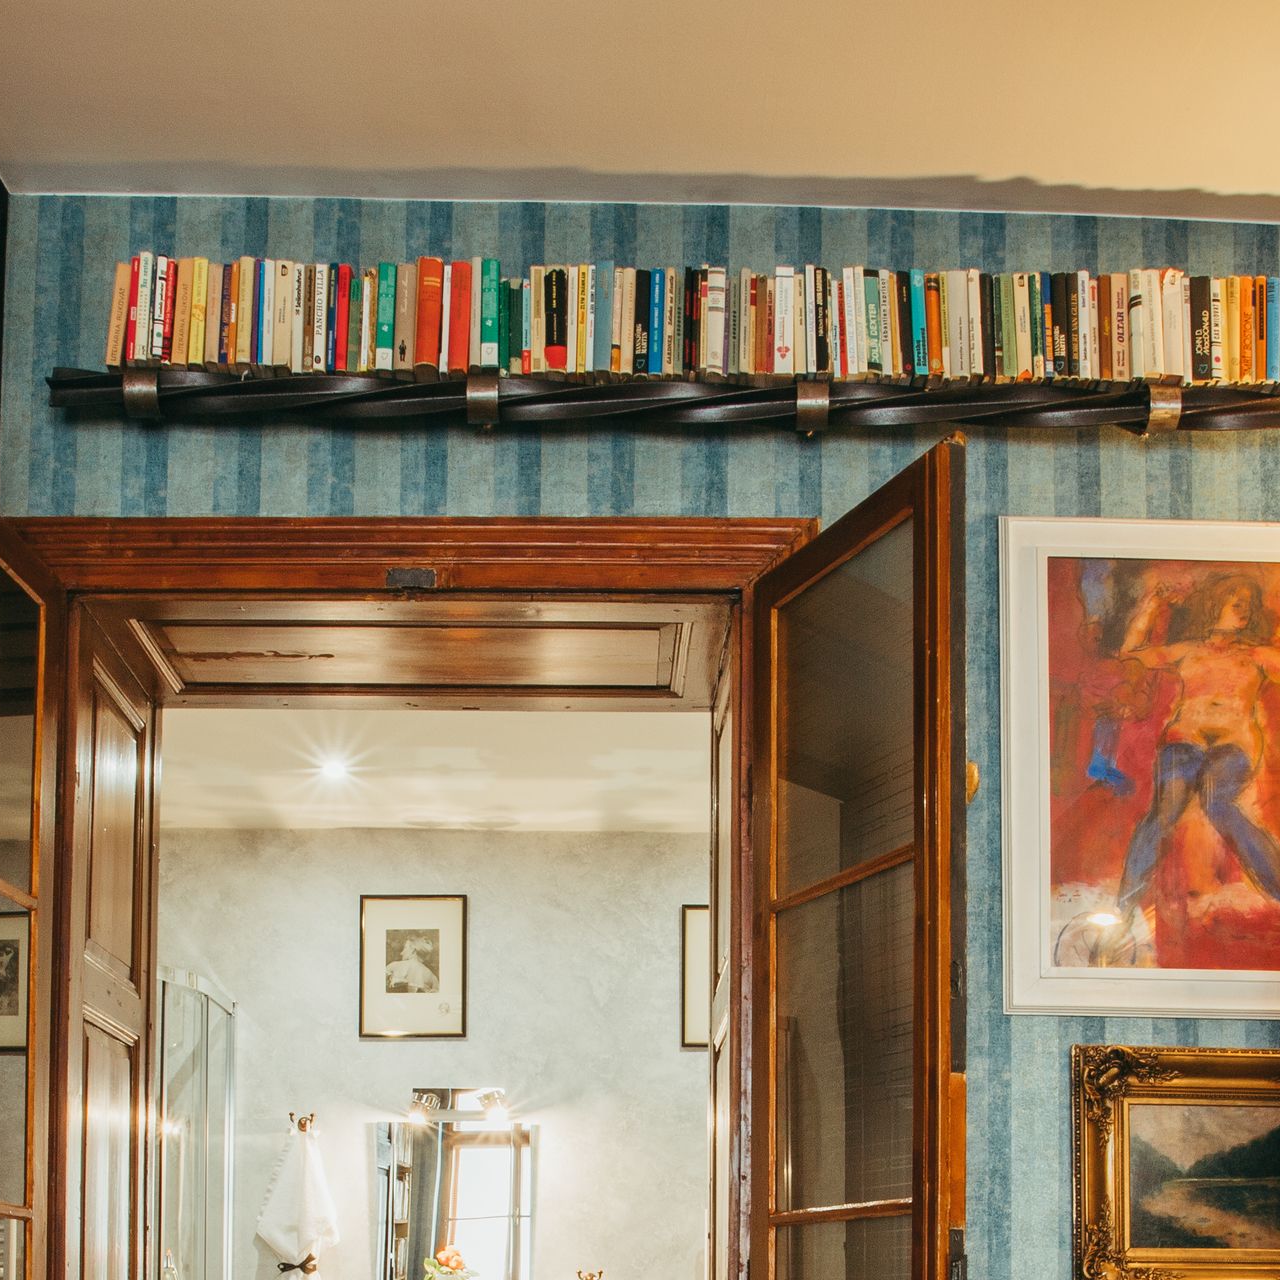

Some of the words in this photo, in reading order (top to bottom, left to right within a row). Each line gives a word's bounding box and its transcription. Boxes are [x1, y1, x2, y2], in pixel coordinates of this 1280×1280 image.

[316, 269, 324, 296] VILLA
[315, 299, 323, 336] PANCHO
[868, 303, 877, 336] DEXTER
[1195, 337, 1203, 355] JOHN
